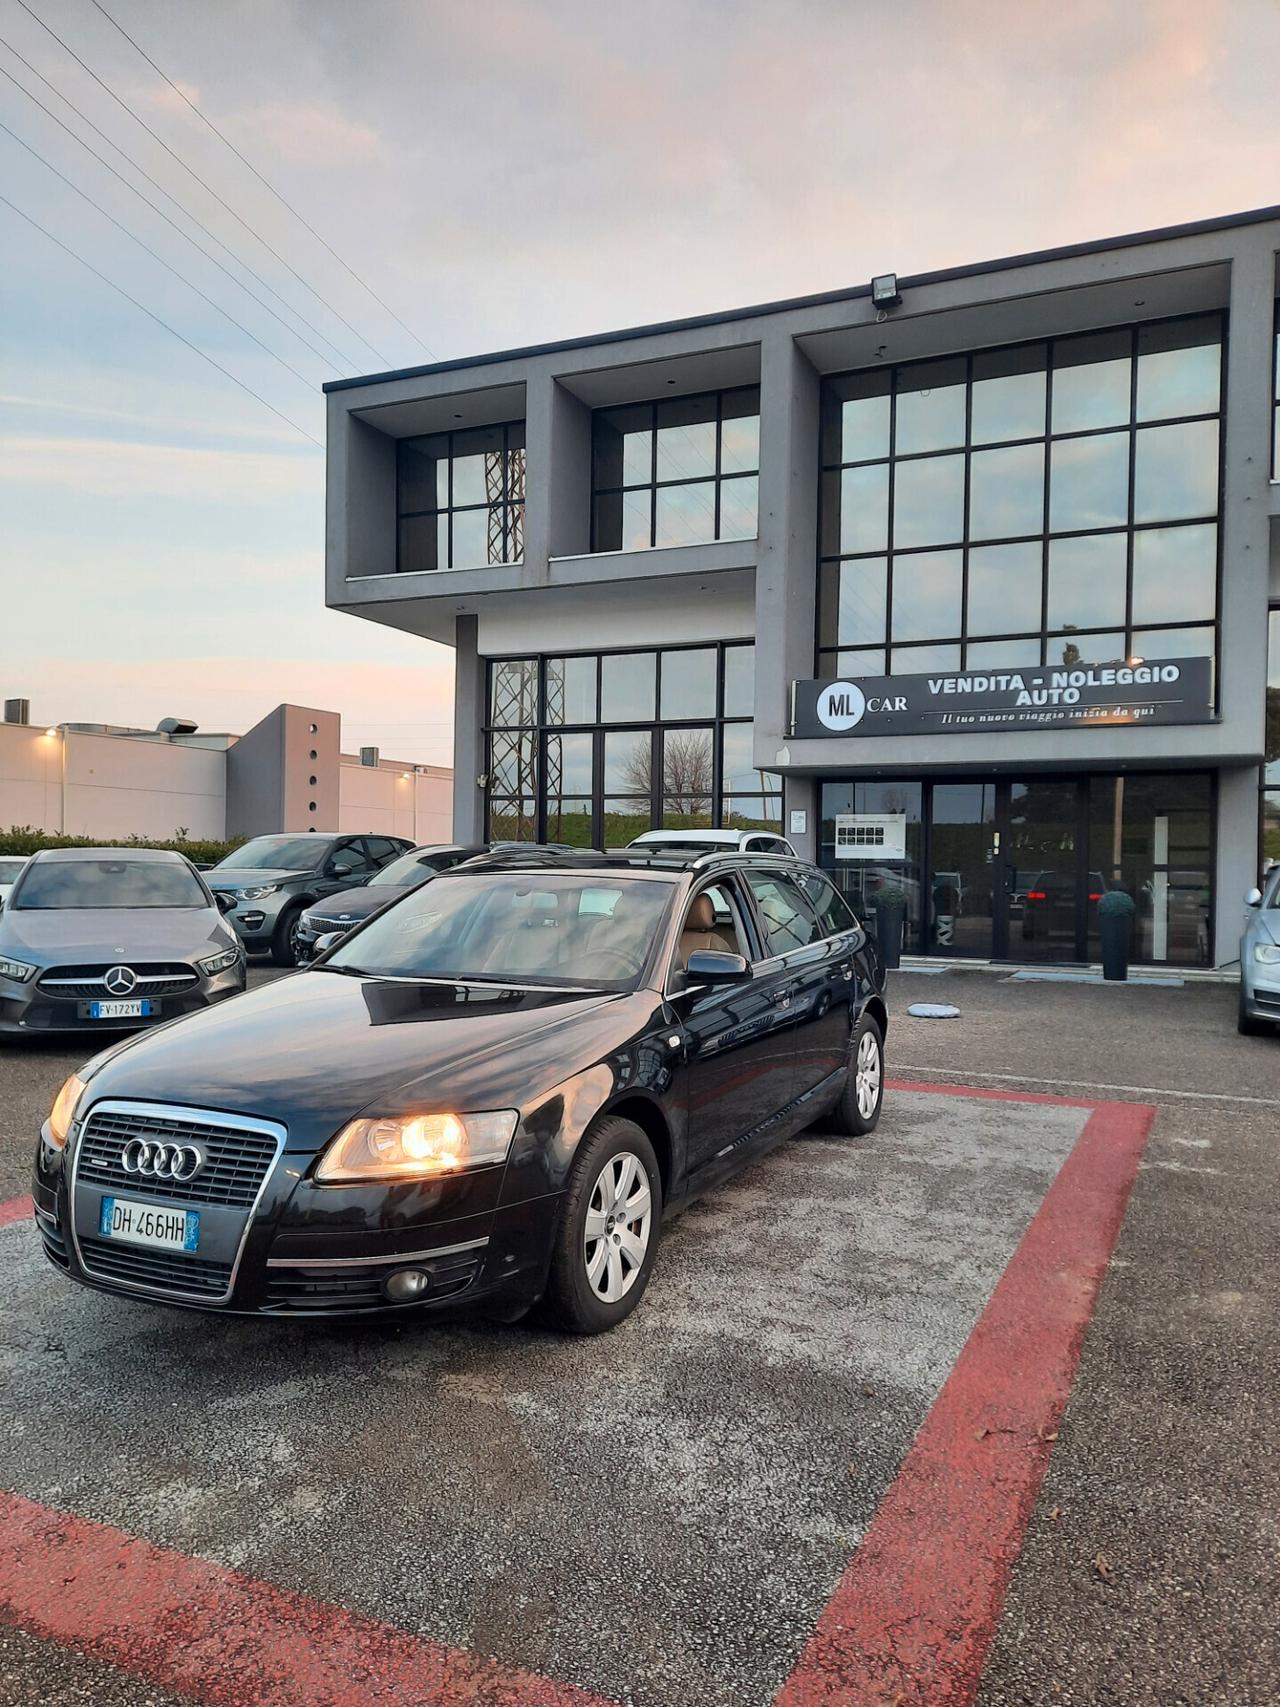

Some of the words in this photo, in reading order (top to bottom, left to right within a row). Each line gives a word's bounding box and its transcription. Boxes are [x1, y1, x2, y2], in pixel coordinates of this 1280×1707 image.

[927, 674, 1026, 695] VENDITA
[1051, 665, 1180, 688] NOLEGGIO
[828, 694, 855, 717] ML
[866, 696, 908, 713] CAR
[1015, 687, 1081, 706] AUTO
[941, 714, 953, 724] Il
[956, 714, 976, 723] tuo
[979, 713, 1016, 722] nuovo
[1019, 710, 1065, 723] viaggio
[1068, 707, 1108, 719] inizia
[1113, 706, 1129, 717] da
[1133, 704, 1156, 719] qui
